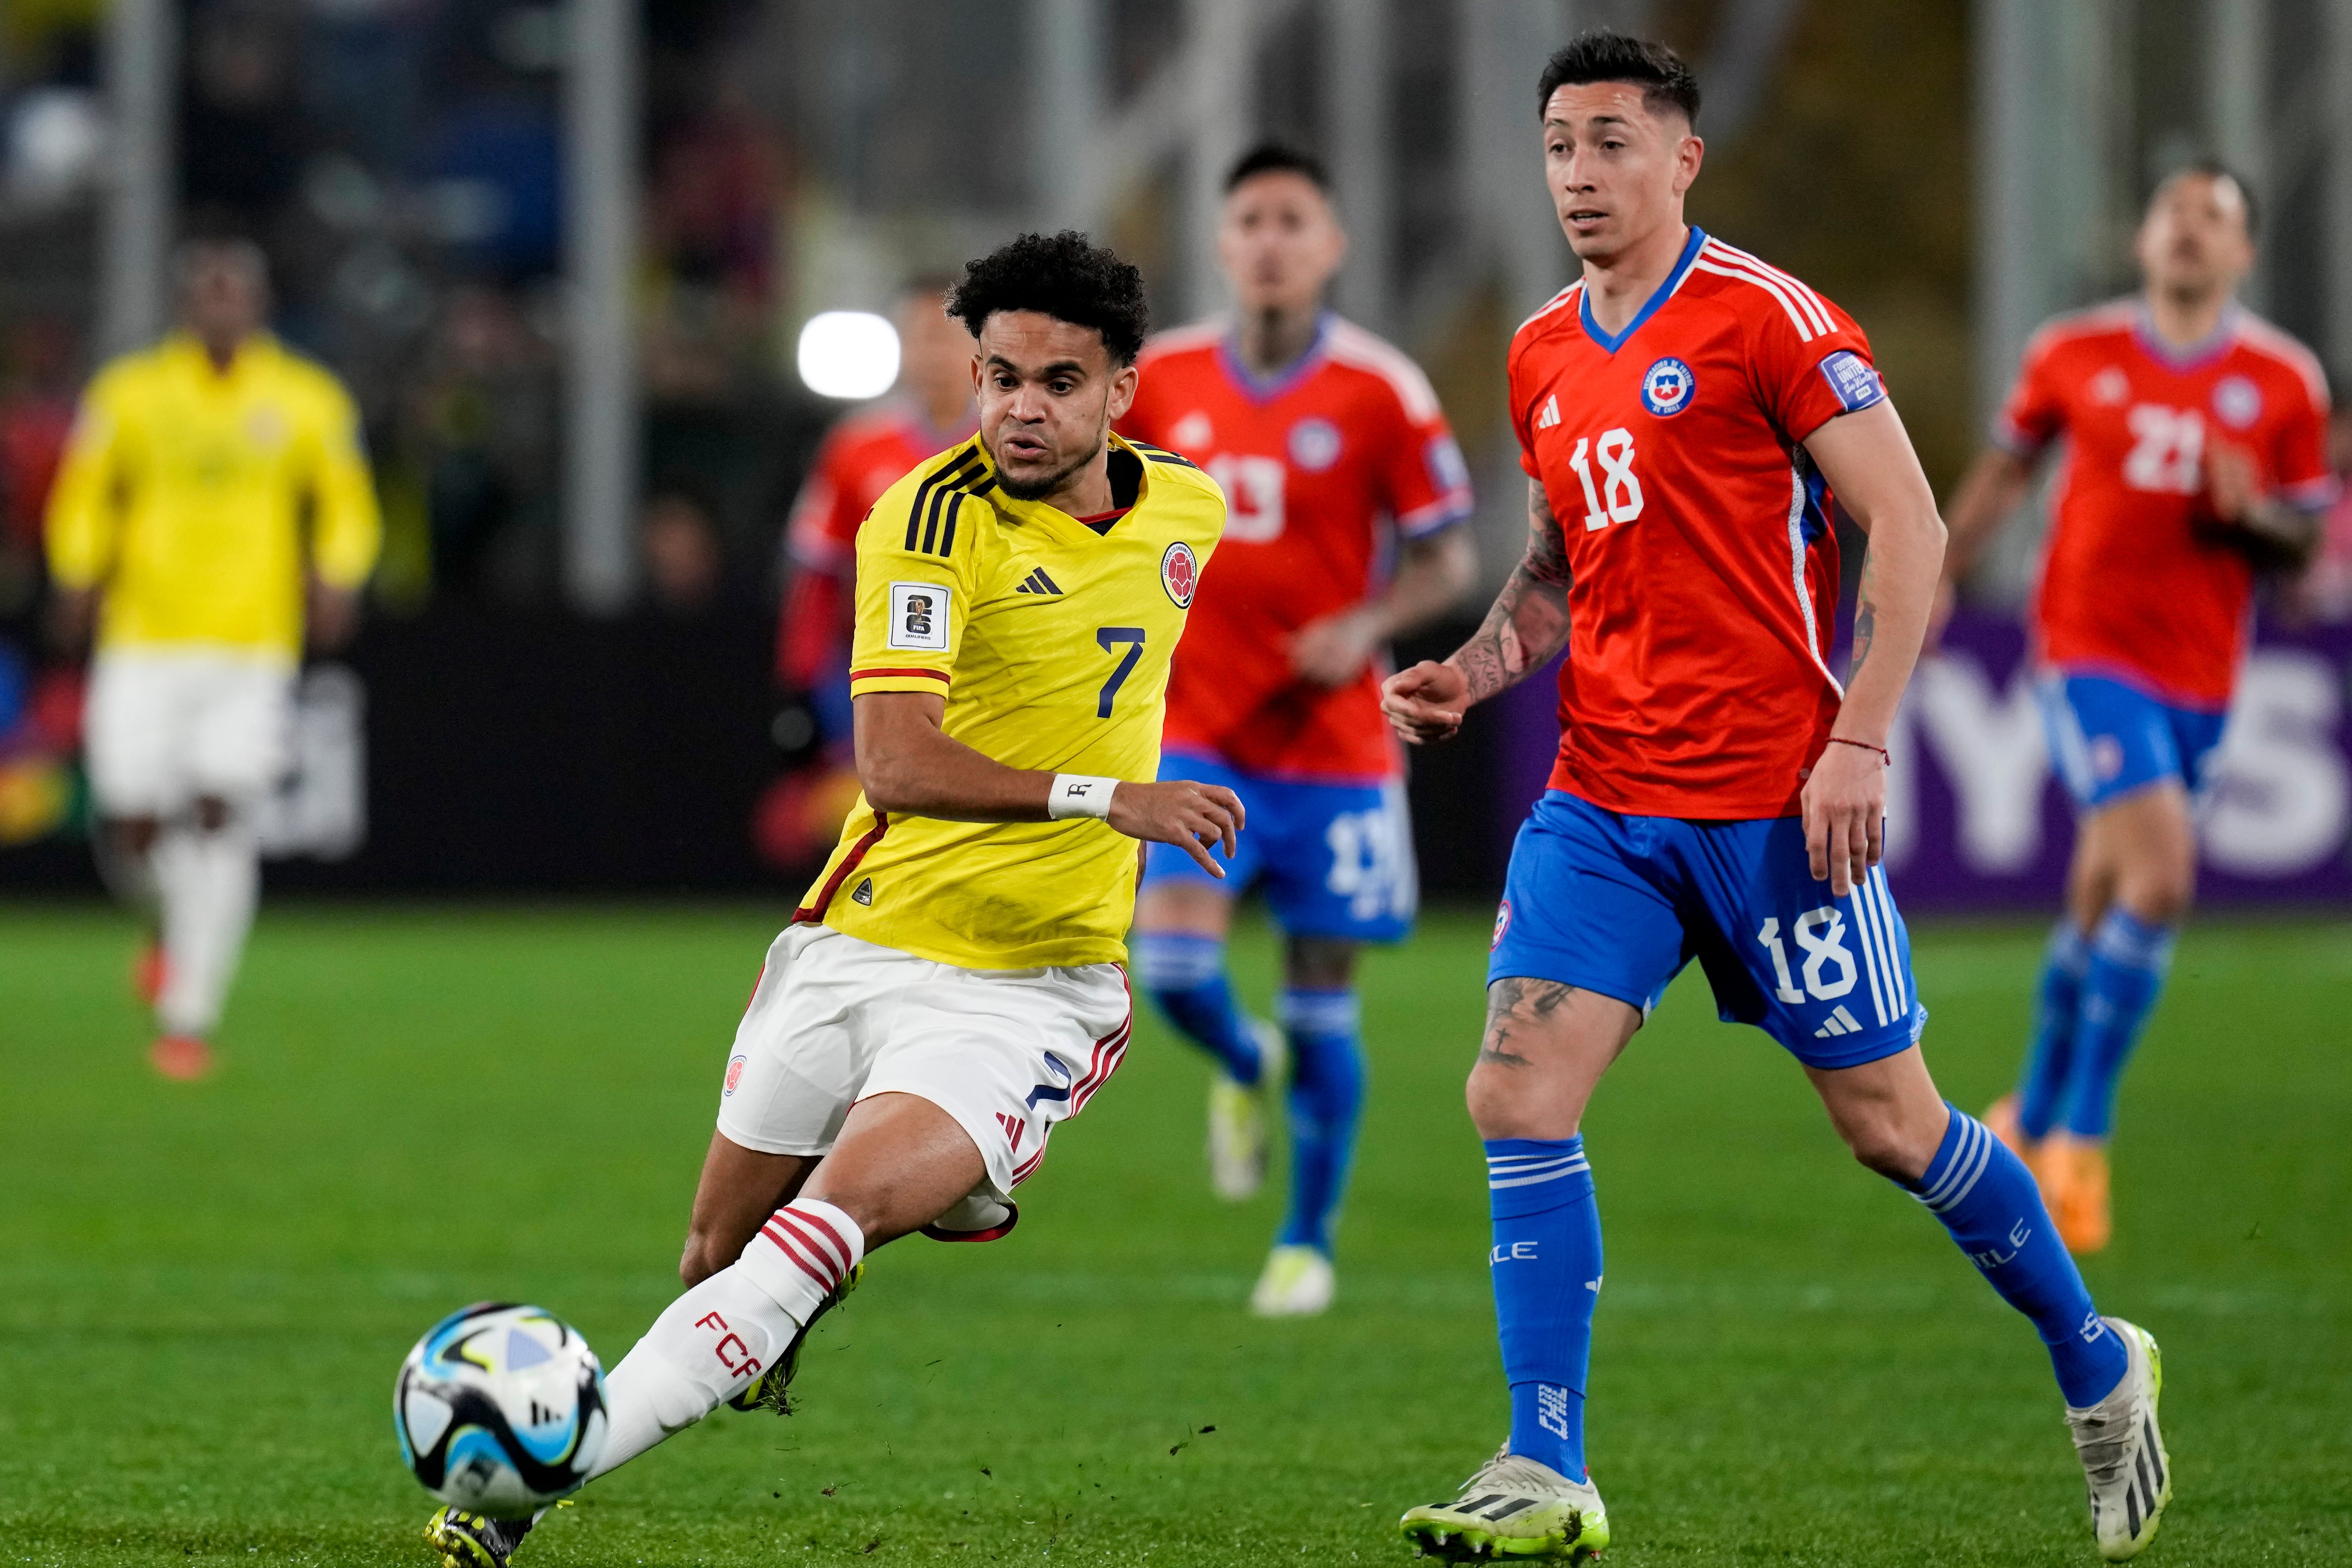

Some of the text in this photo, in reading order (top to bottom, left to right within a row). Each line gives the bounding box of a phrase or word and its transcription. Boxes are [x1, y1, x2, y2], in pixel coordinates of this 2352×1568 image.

[1663, 403, 1680, 414] CHILE
[1569, 427, 1644, 532] 18
[1164, 551, 1173, 575] FEDERACION
[1171, 546, 1188, 554] COLOMBIANA
[1097, 627, 1145, 719] 7
[1067, 784, 1092, 797] R
[1758, 906, 1858, 1004] 18
[695, 1312, 762, 1378] FCF
